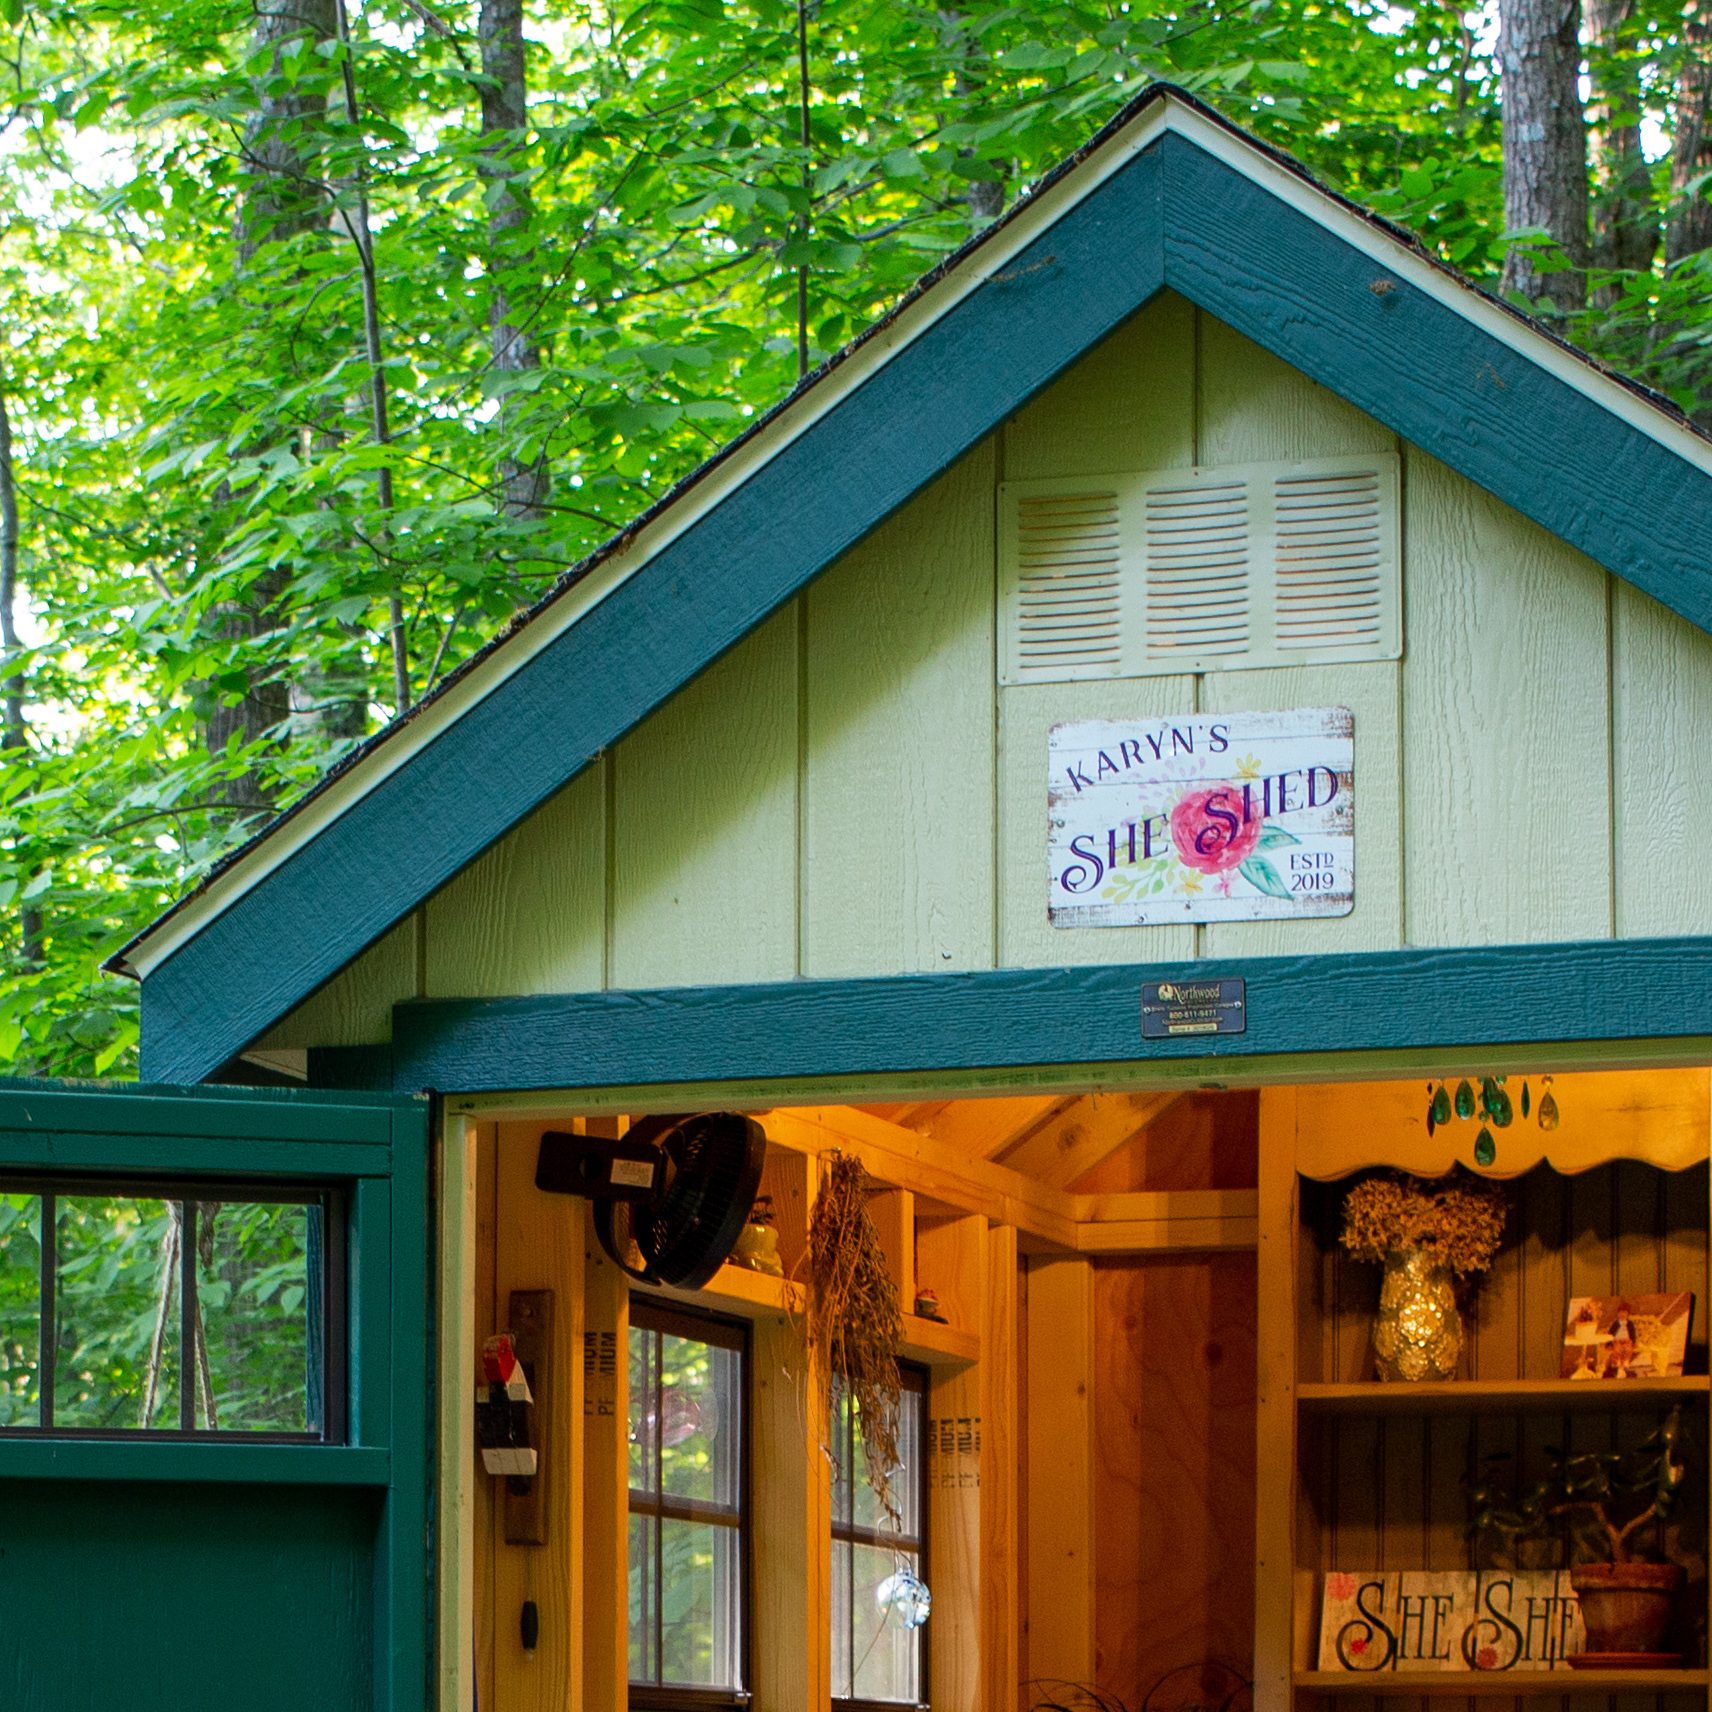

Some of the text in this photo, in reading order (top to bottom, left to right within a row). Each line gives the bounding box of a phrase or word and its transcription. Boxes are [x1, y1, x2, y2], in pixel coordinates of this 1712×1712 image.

[1066, 724, 1231, 793] KARYN'S
[1060, 765, 1339, 893] SHE SHED
[1290, 872, 1335, 891] 2019
[1335, 1577, 1454, 1672] SHE
